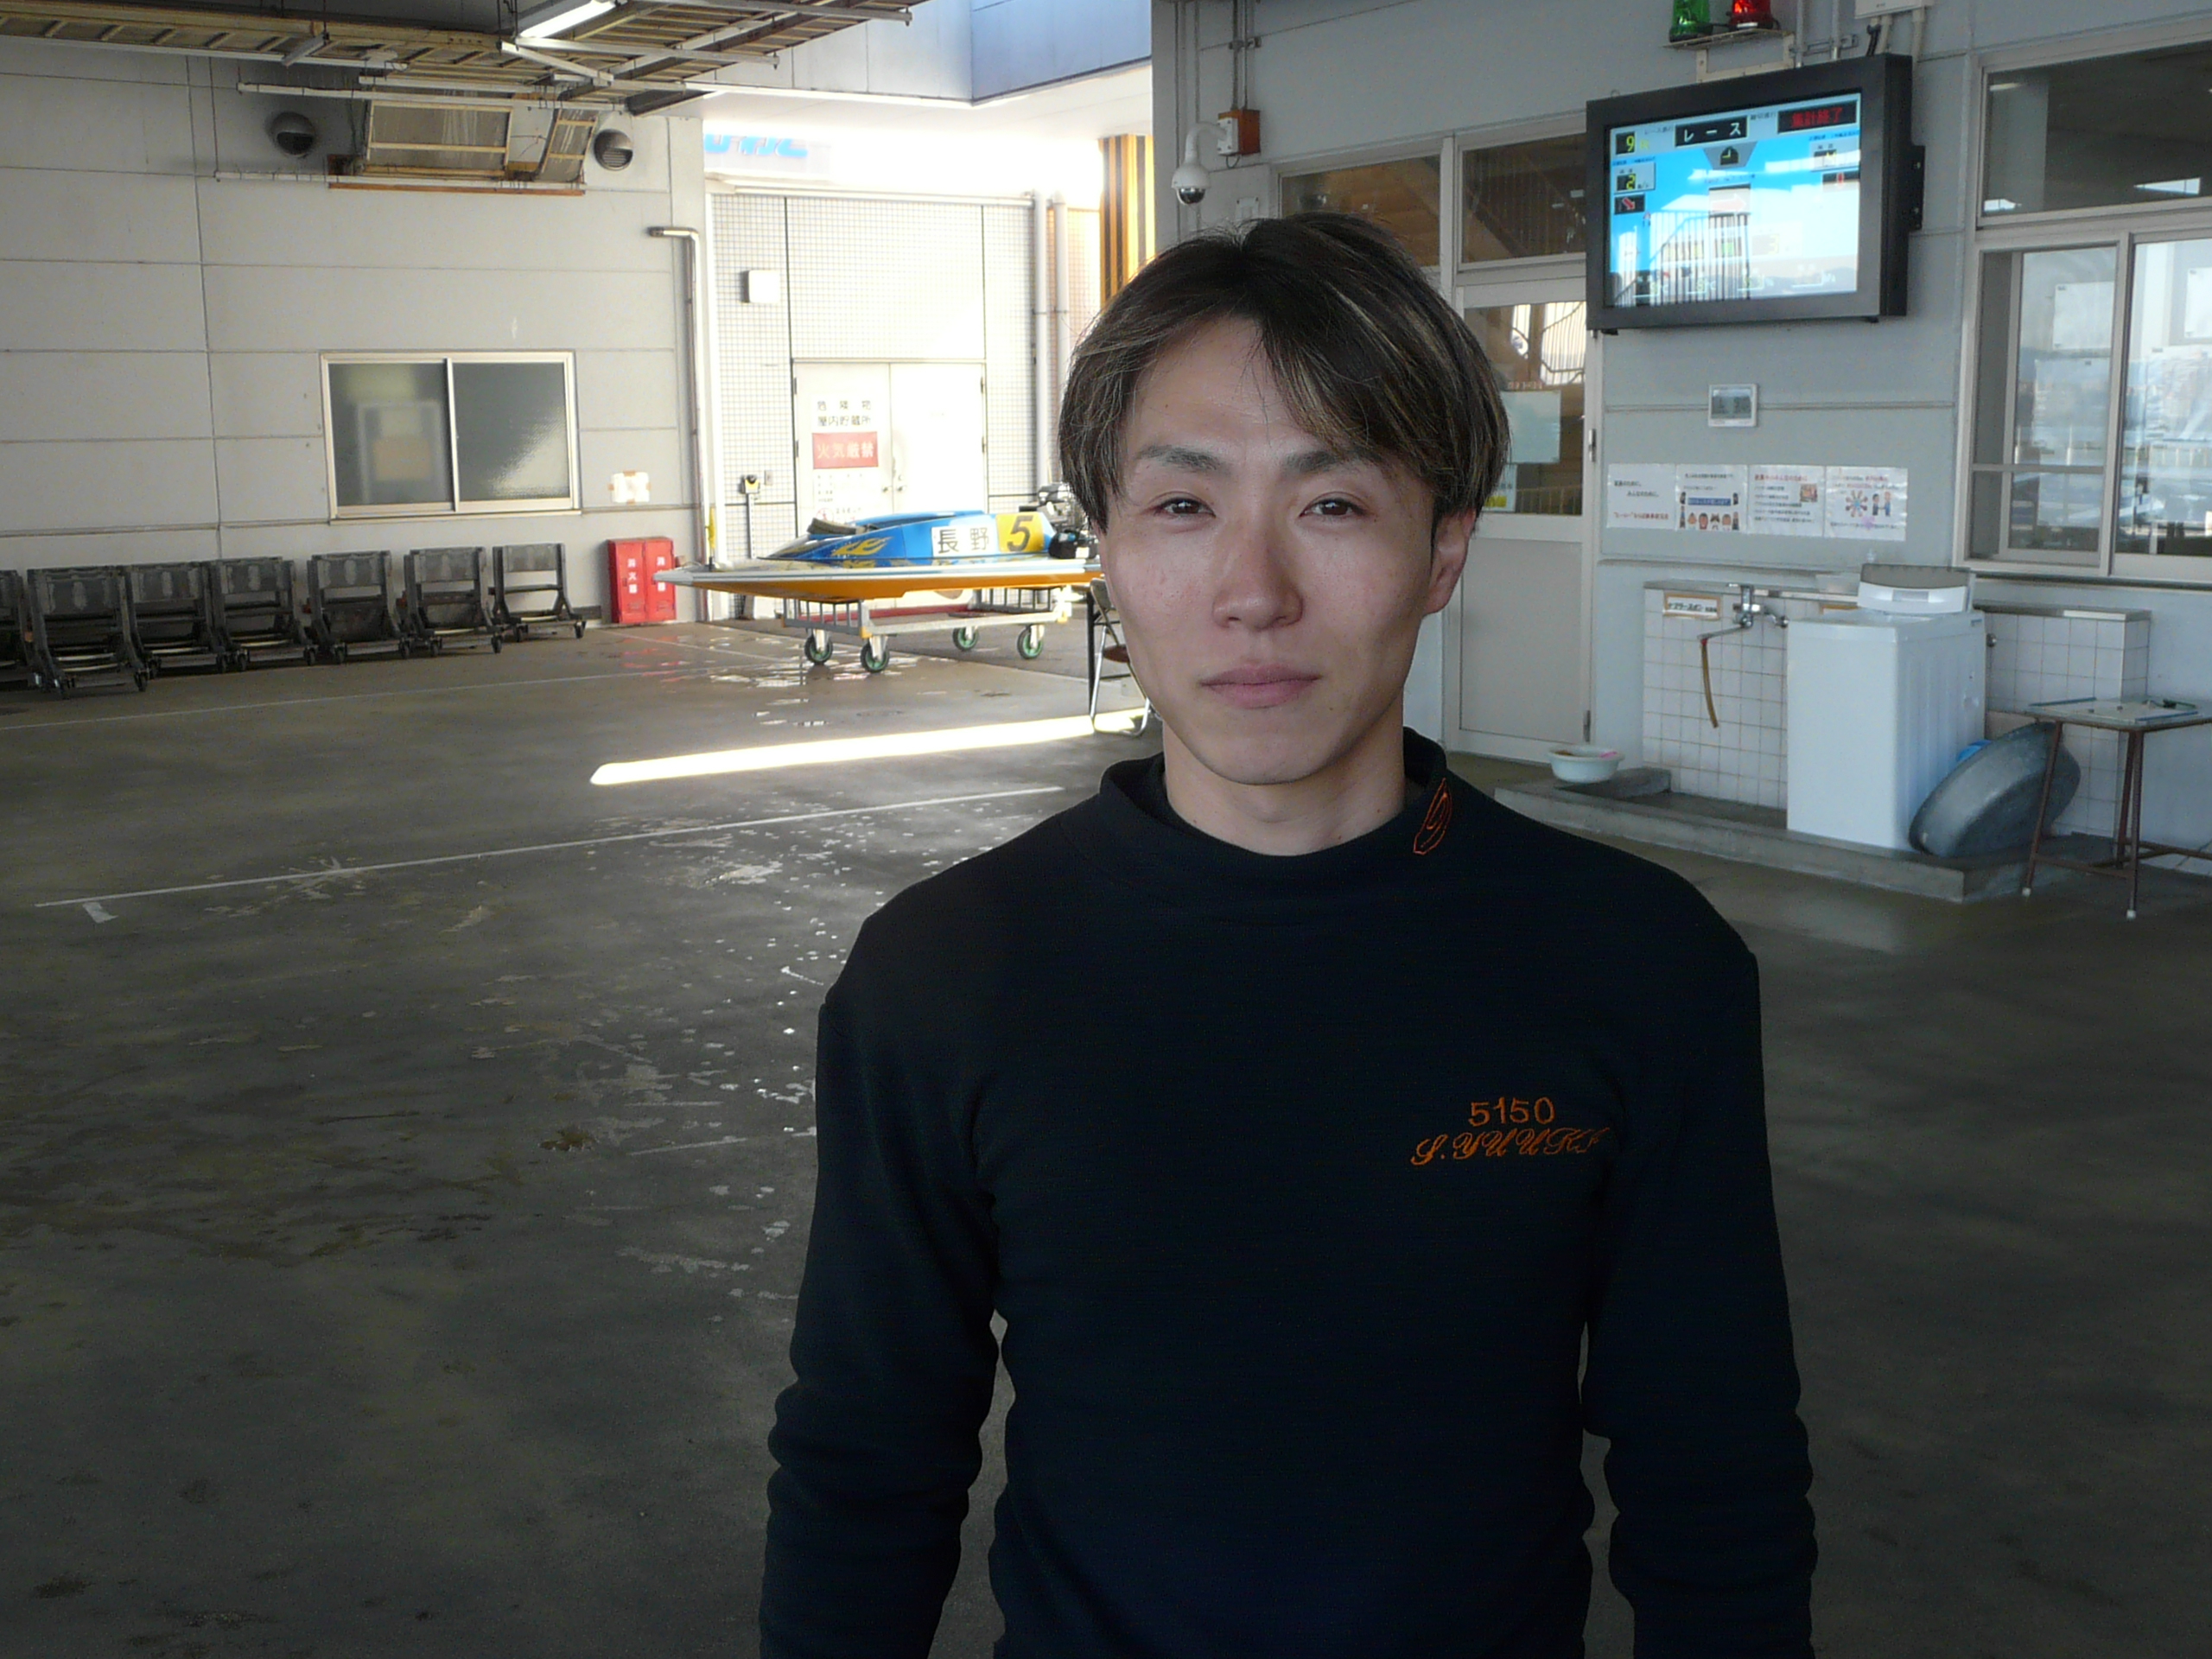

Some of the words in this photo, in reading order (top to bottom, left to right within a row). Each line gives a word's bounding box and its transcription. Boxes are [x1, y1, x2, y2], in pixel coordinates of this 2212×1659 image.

[1791, 106, 1843, 129] 集計終了
[1626, 135, 1636, 153] 9
[1683, 122, 1743, 143] レース
[1626, 174, 1637, 191] 2
[817, 441, 874, 459] 火気厳禁
[938, 526, 990, 555] 長野
[1007, 514, 1034, 553] 5
[656, 556, 666, 592] 消器
[1469, 1096, 1556, 1127] 5150
